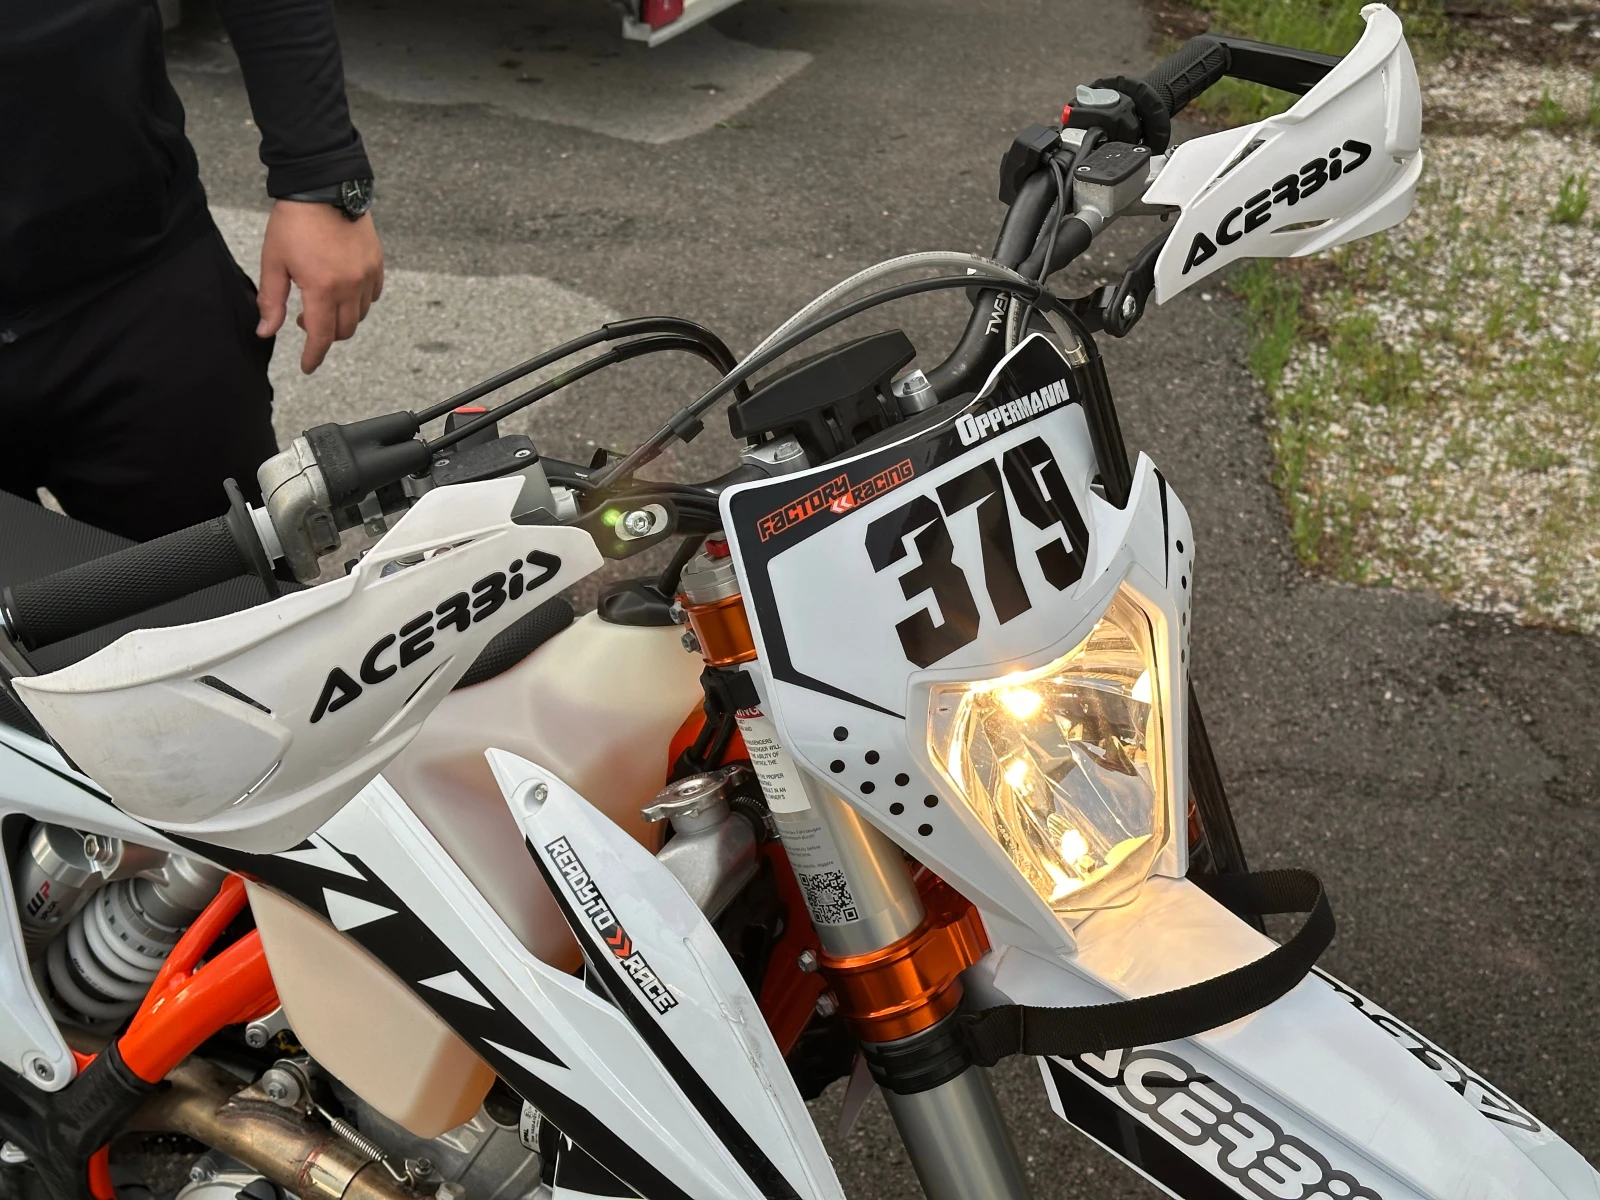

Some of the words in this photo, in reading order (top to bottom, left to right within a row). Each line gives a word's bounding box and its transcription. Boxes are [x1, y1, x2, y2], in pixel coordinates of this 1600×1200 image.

[955, 378, 1070, 447] OPPERMANN
[864, 436, 1089, 669] 379
[546, 837, 600, 904] READY
[622, 952, 679, 1014] RACE
